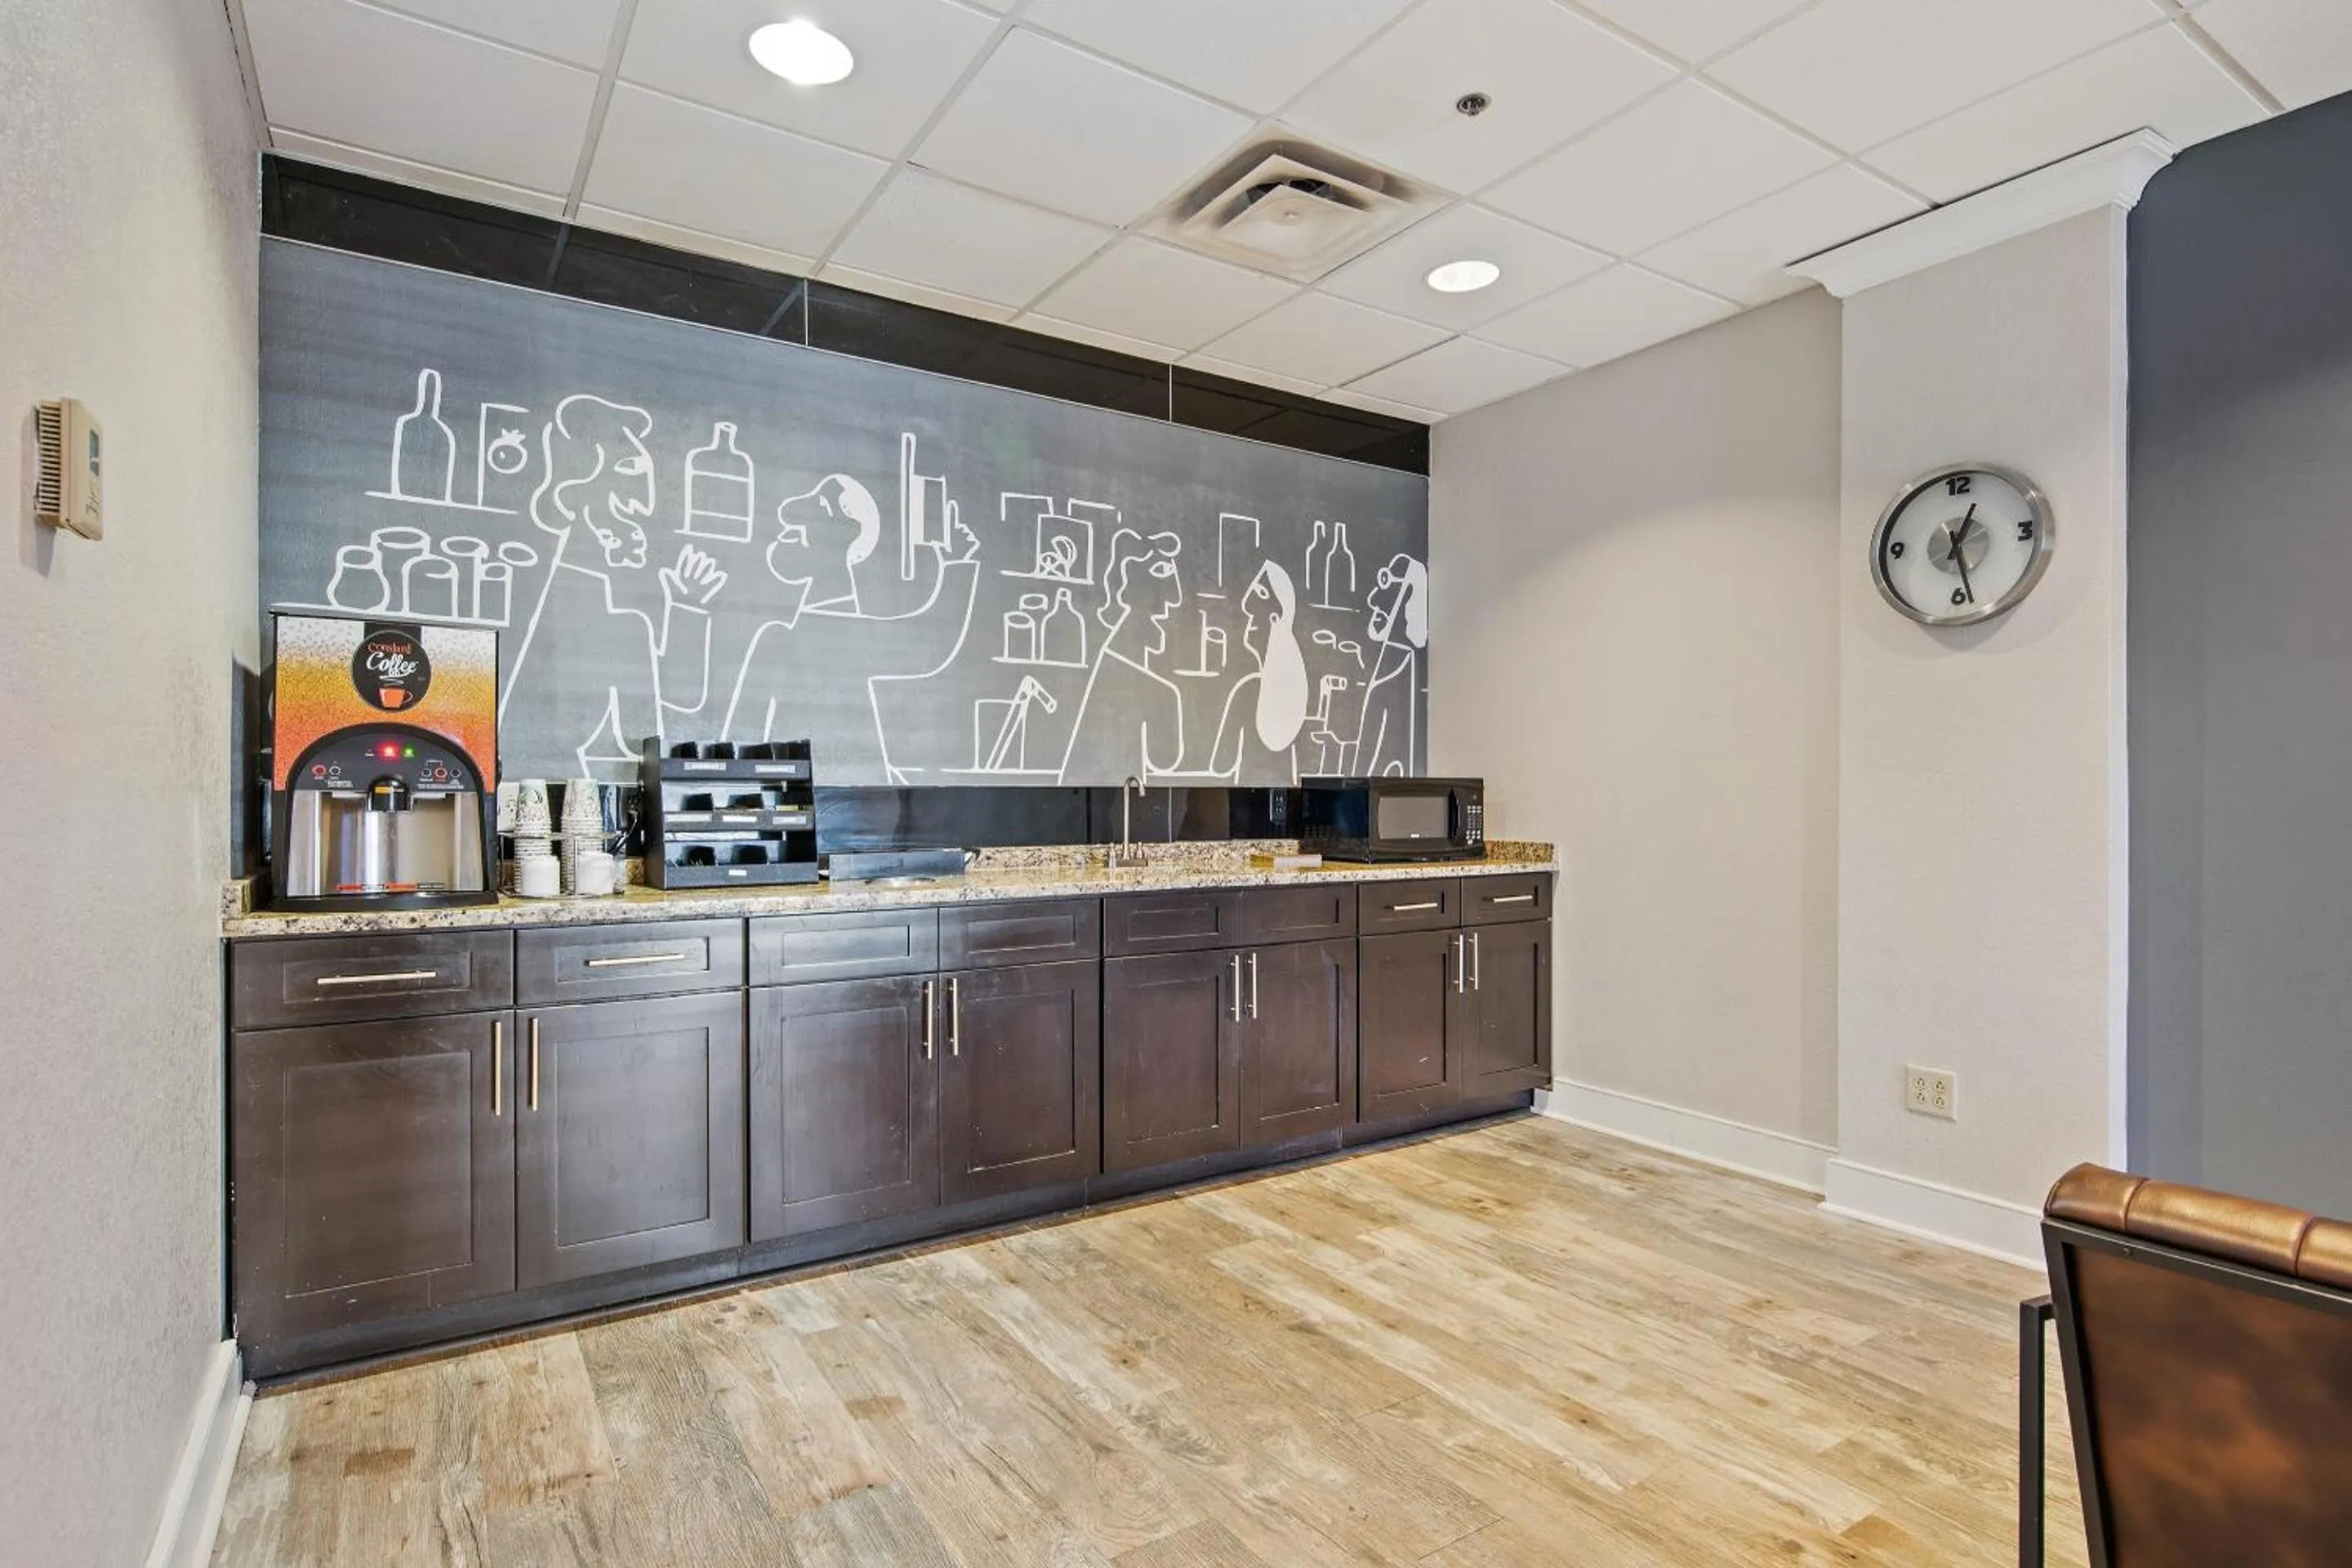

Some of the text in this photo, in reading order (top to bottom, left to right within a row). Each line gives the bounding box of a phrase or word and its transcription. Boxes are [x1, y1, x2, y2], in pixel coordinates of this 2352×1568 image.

[1945, 476, 1971, 497] 12
[2017, 520, 2033, 541] 3
[1890, 541, 1904, 559] 9
[1950, 587, 1967, 605] 6
[366, 652, 419, 678] Coffee
